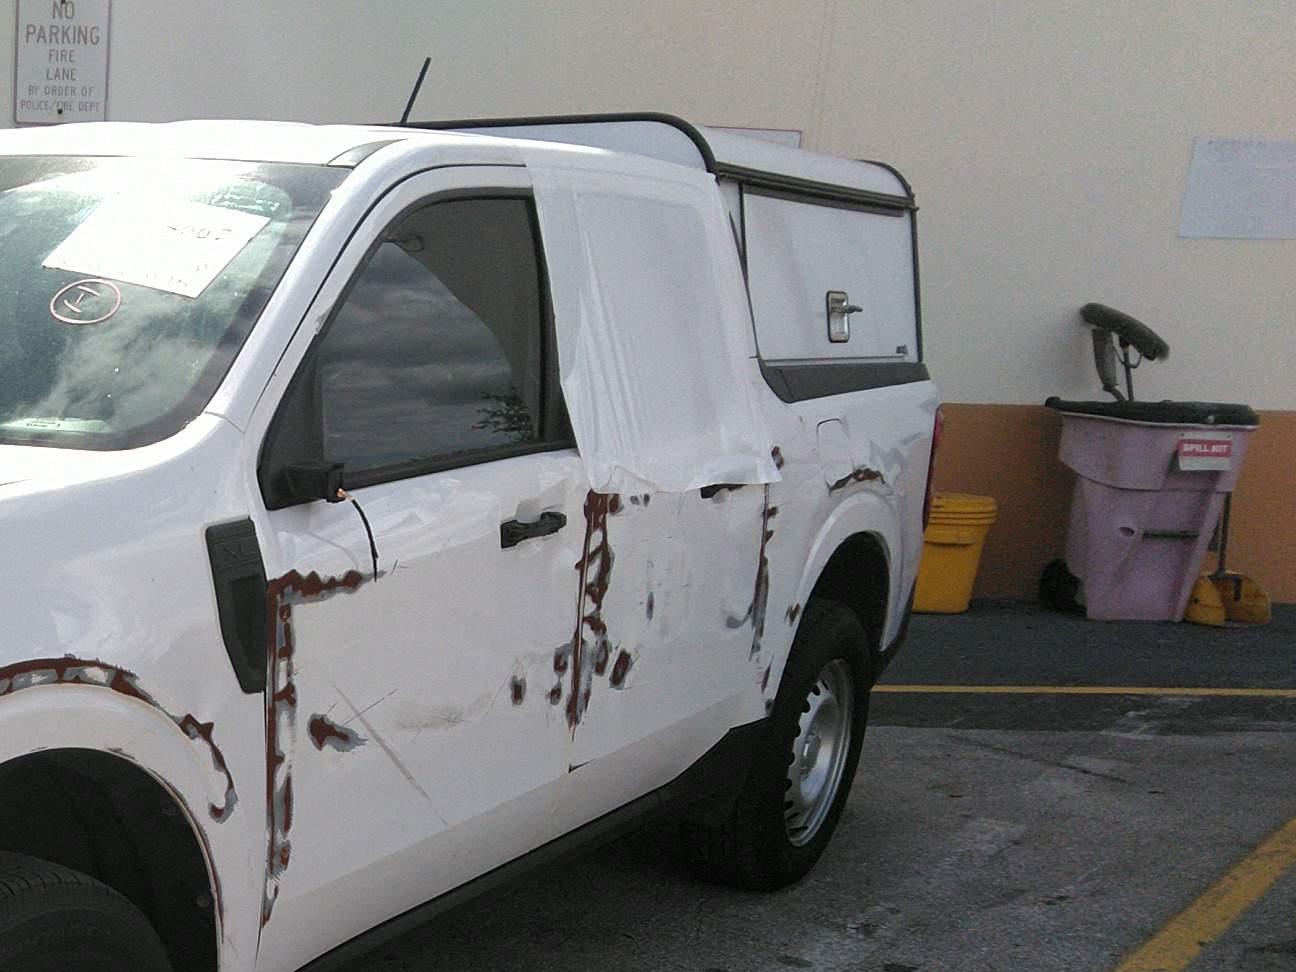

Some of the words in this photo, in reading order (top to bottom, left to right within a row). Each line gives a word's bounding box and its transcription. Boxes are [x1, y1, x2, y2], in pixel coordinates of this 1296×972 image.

[52, 1, 75, 20] NO
[26, 24, 100, 45] PARKING
[49, 49, 76, 63] FIRE
[46, 68, 77, 81] LANE
[28, 85, 39, 96] BY
[44, 86, 76, 97] ORDER
[81, 87, 94, 97] OF
[78, 101, 100, 112] DEPT
